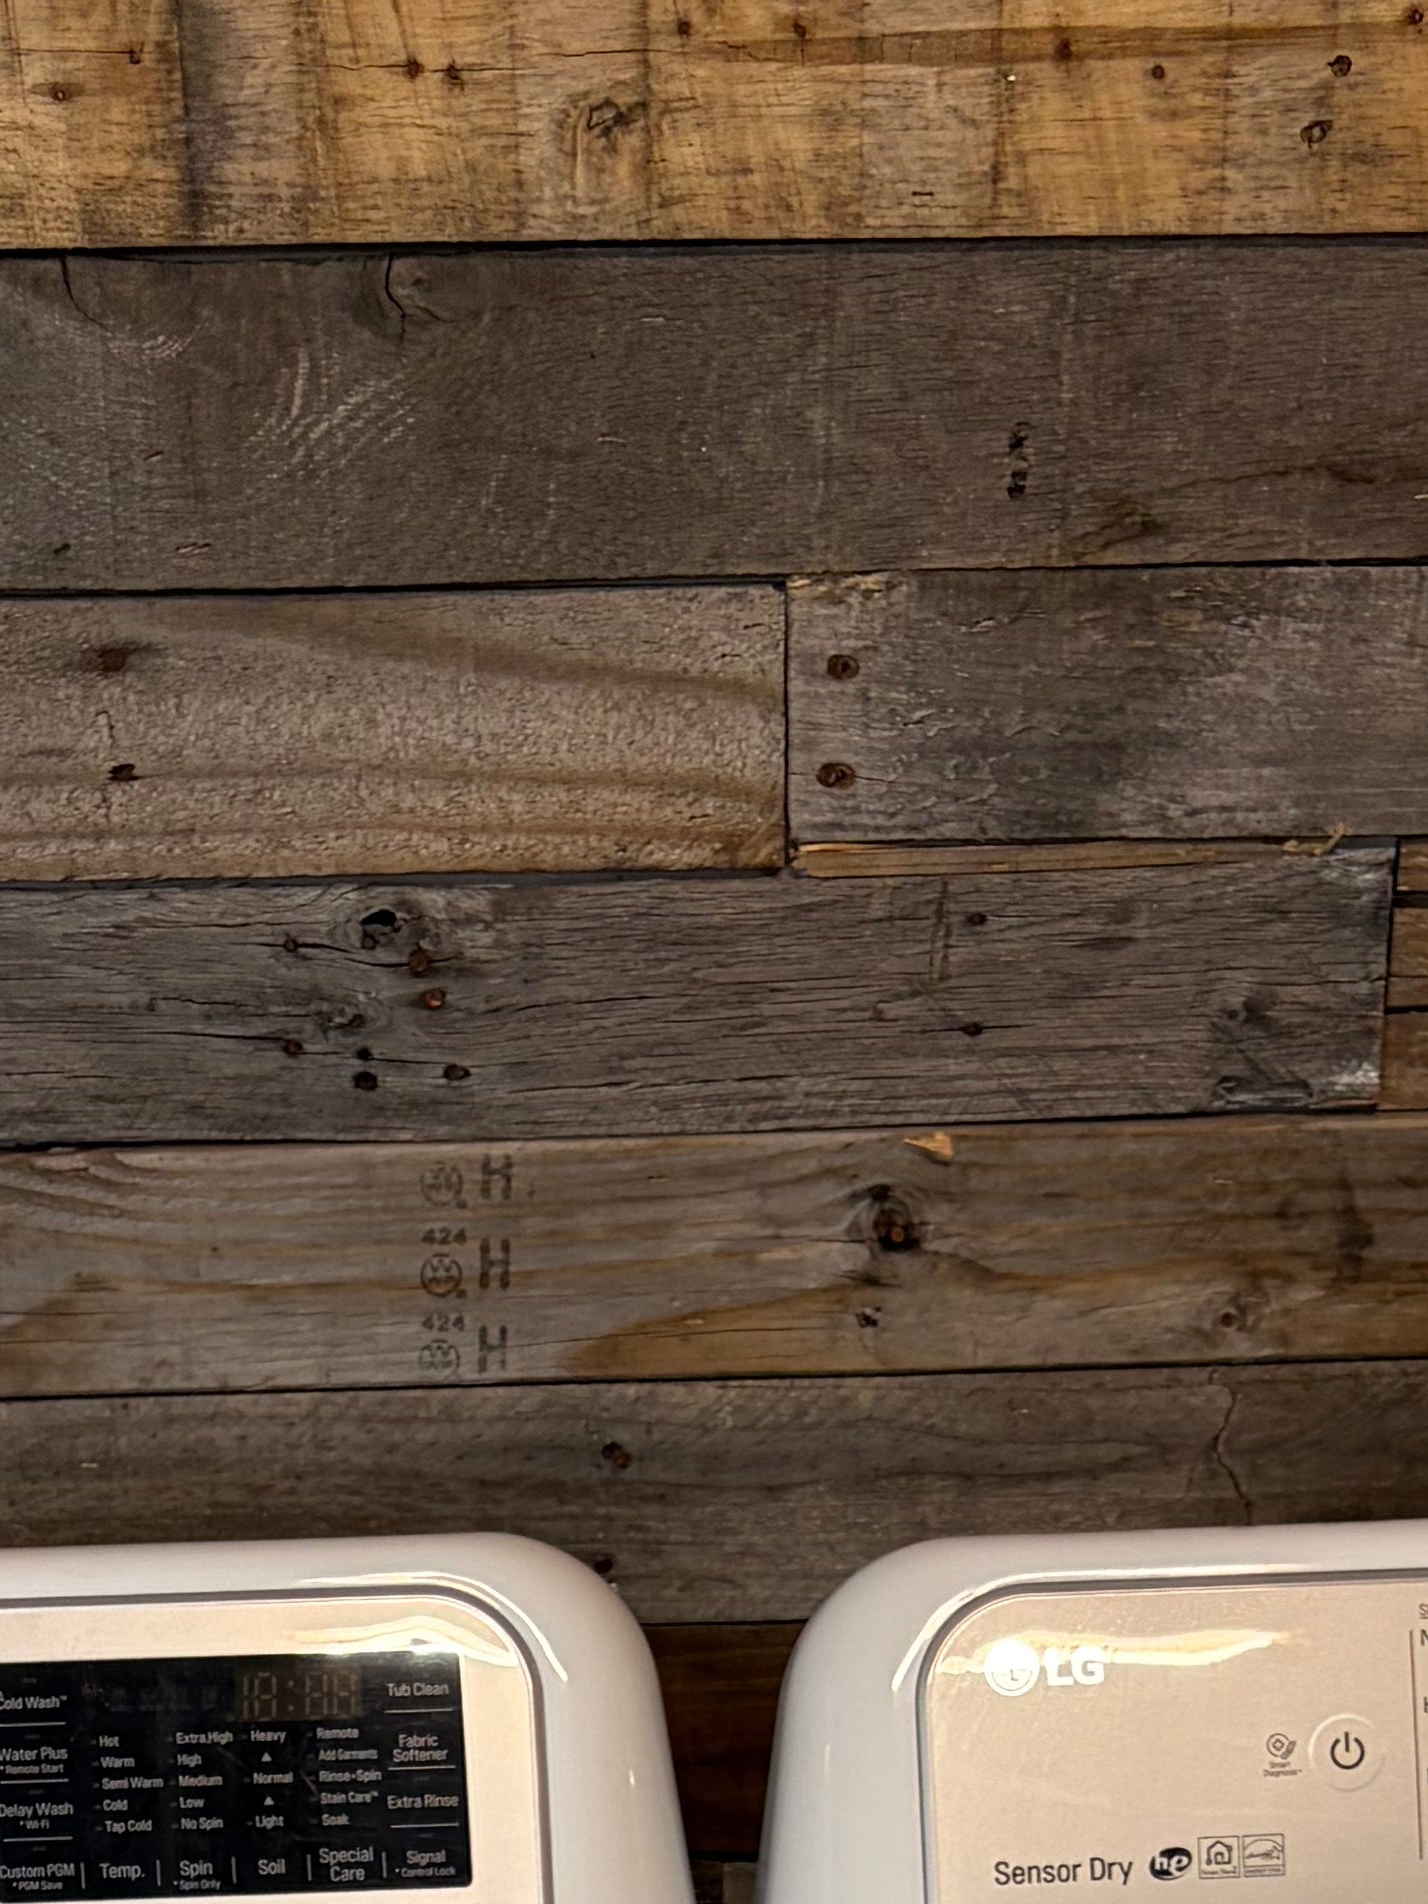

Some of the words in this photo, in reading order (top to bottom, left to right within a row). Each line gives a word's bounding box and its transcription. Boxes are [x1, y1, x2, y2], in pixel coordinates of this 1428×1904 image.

[422, 1227, 468, 1246] 424
[1043, 1645, 1105, 1686] LG
[386, 1684, 411, 1697] Tub
[412, 1683, 449, 1696] Clean
[176, 1732, 205, 1744] Extra
[251, 1730, 286, 1743] Heavy
[316, 1728, 359, 1740] Remote
[398, 1734, 439, 1748] Fabric
[99, 1736, 119, 1748] Hot
[40, 1746, 68, 1760] Plus
[177, 1753, 202, 1767] High
[393, 1748, 449, 1762] Softener
[101, 1757, 135, 1768] Warm
[102, 1779, 128, 1789] Semi
[130, 1777, 164, 1788] Warm
[178, 1775, 223, 1787] Medium
[253, 1772, 293, 1784] Normal
[103, 1800, 128, 1811] Cold
[179, 1797, 205, 1808] Low
[387, 1795, 422, 1809] Extra
[423, 1794, 459, 1808] Rinse
[35, 1802, 73, 1816] Wash
[181, 1818, 197, 1829] No
[199, 1817, 223, 1830] Spin
[256, 1816, 284, 1829] Light
[322, 1813, 349, 1826] Soak
[105, 1821, 125, 1834] Tap
[127, 1820, 152, 1831] Cold
[319, 1847, 374, 1865] Special
[406, 1850, 446, 1866] Signal
[47, 1863, 75, 1877] PGM
[99, 1863, 145, 1880] Temp.
[179, 1860, 213, 1878] Spin
[258, 1859, 286, 1875] Soil
[330, 1866, 365, 1882] Care
[994, 1861, 1082, 1886] Sensor
[1090, 1857, 1133, 1885] Dry
